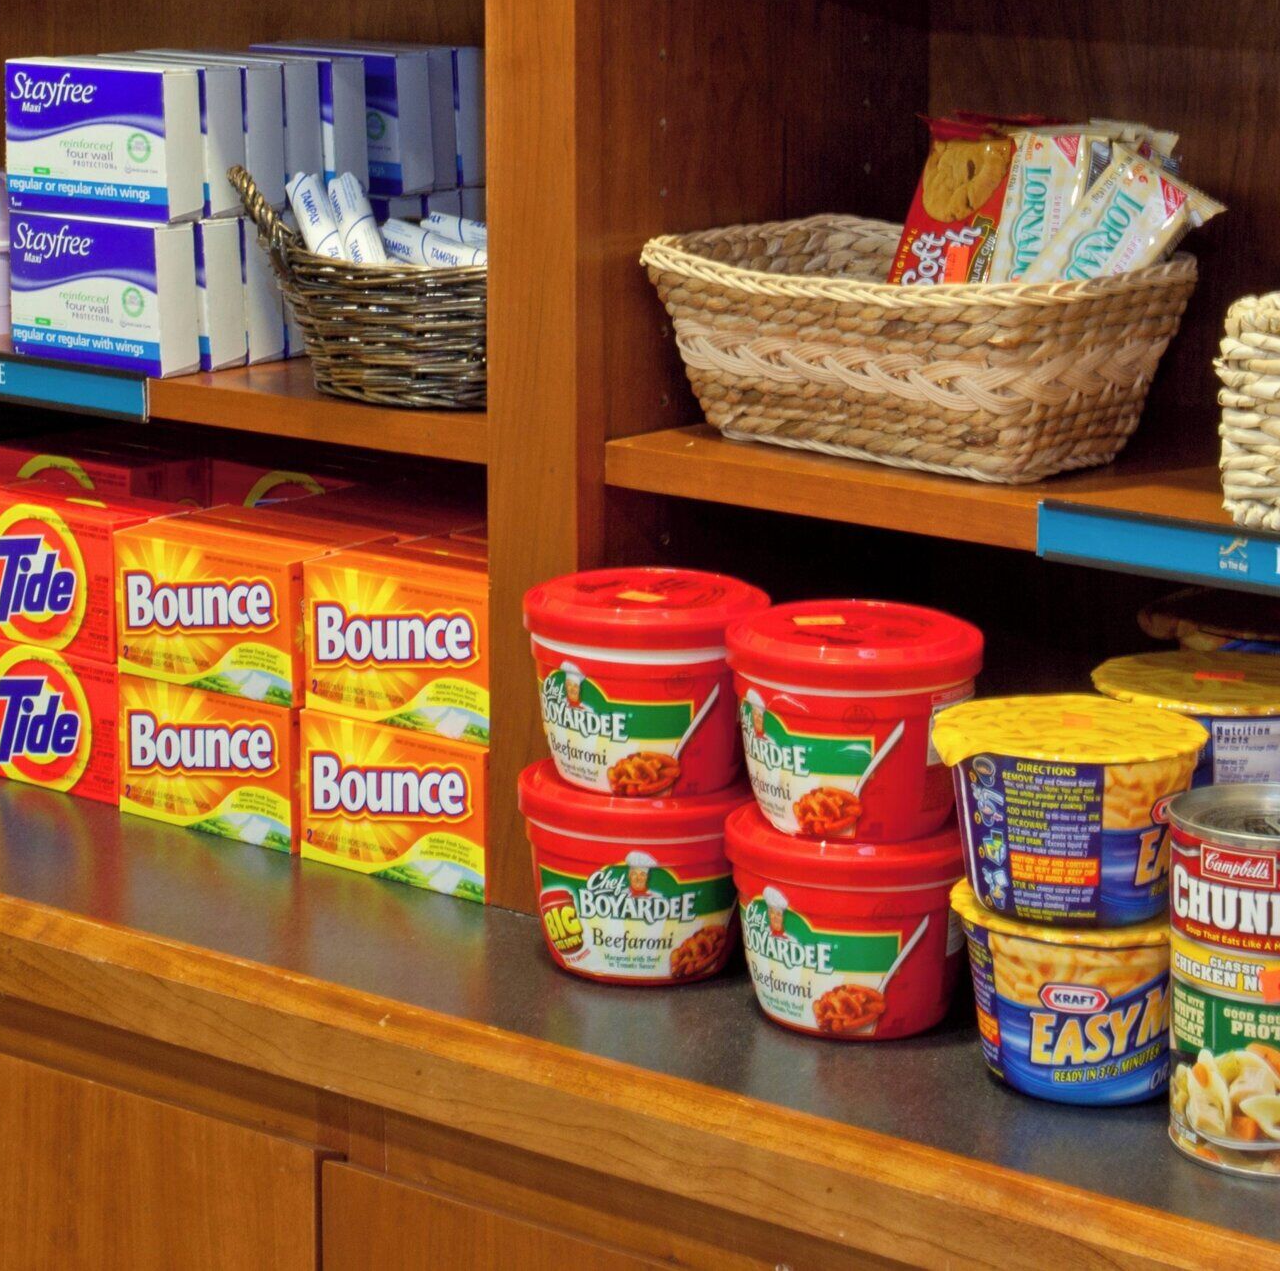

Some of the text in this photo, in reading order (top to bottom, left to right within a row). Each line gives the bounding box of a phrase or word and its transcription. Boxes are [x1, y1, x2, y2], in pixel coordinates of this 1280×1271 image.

[11, 72, 95, 107] Stayfree
[21, 101, 42, 114] Maxi
[59, 138, 113, 151] reinforced
[66, 149, 113, 161] four wall
[73, 159, 114, 170] PROTECTION
[9, 179, 150, 202] regular or regular with wings
[300, 188, 319, 226] TAMPAX
[13, 222, 92, 258] Stayfree
[384, 238, 411, 256] TAMPAX
[430, 248, 460, 266] TAMPAX
[126, 573, 272, 628] Bounce
[316, 606, 472, 662] Bounce
[542, 675, 565, 697] Chef
[541, 697, 629, 743] BOYARDEE
[1216, 726, 1270, 735] Nutrition
[130, 714, 273, 769] Bounce
[549, 731, 608, 766] Beefaroni
[1217, 736, 1249, 744] Facts
[1002, 772, 1034, 783] REMOVE
[1017, 763, 1076, 776] DIRECTIONS
[311, 755, 466, 815] Bounce
[1006, 806, 1044, 818] ADD WATER
[585, 869, 626, 894] Chef
[579, 889, 697, 923] BOYARDEE
[745, 904, 768, 930] Chef
[545, 904, 582, 937] BIG
[592, 928, 673, 952] Beefaroni
[1186, 924, 1271, 950] Soup That Eats Like A
[1174, 952, 1237, 988] CHICKEN
[1209, 957, 1264, 973] CLASSIC
[752, 964, 812, 999] Beefaroni
[1054, 991, 1096, 1008] KRAFT
[1174, 997, 1205, 1024] WHITE
[1174, 1014, 1205, 1038] MEAT
[1223, 1008, 1254, 1021] GOOD
[1029, 1011, 1143, 1066] EASY
[1053, 1066, 1097, 1083] READY IN
